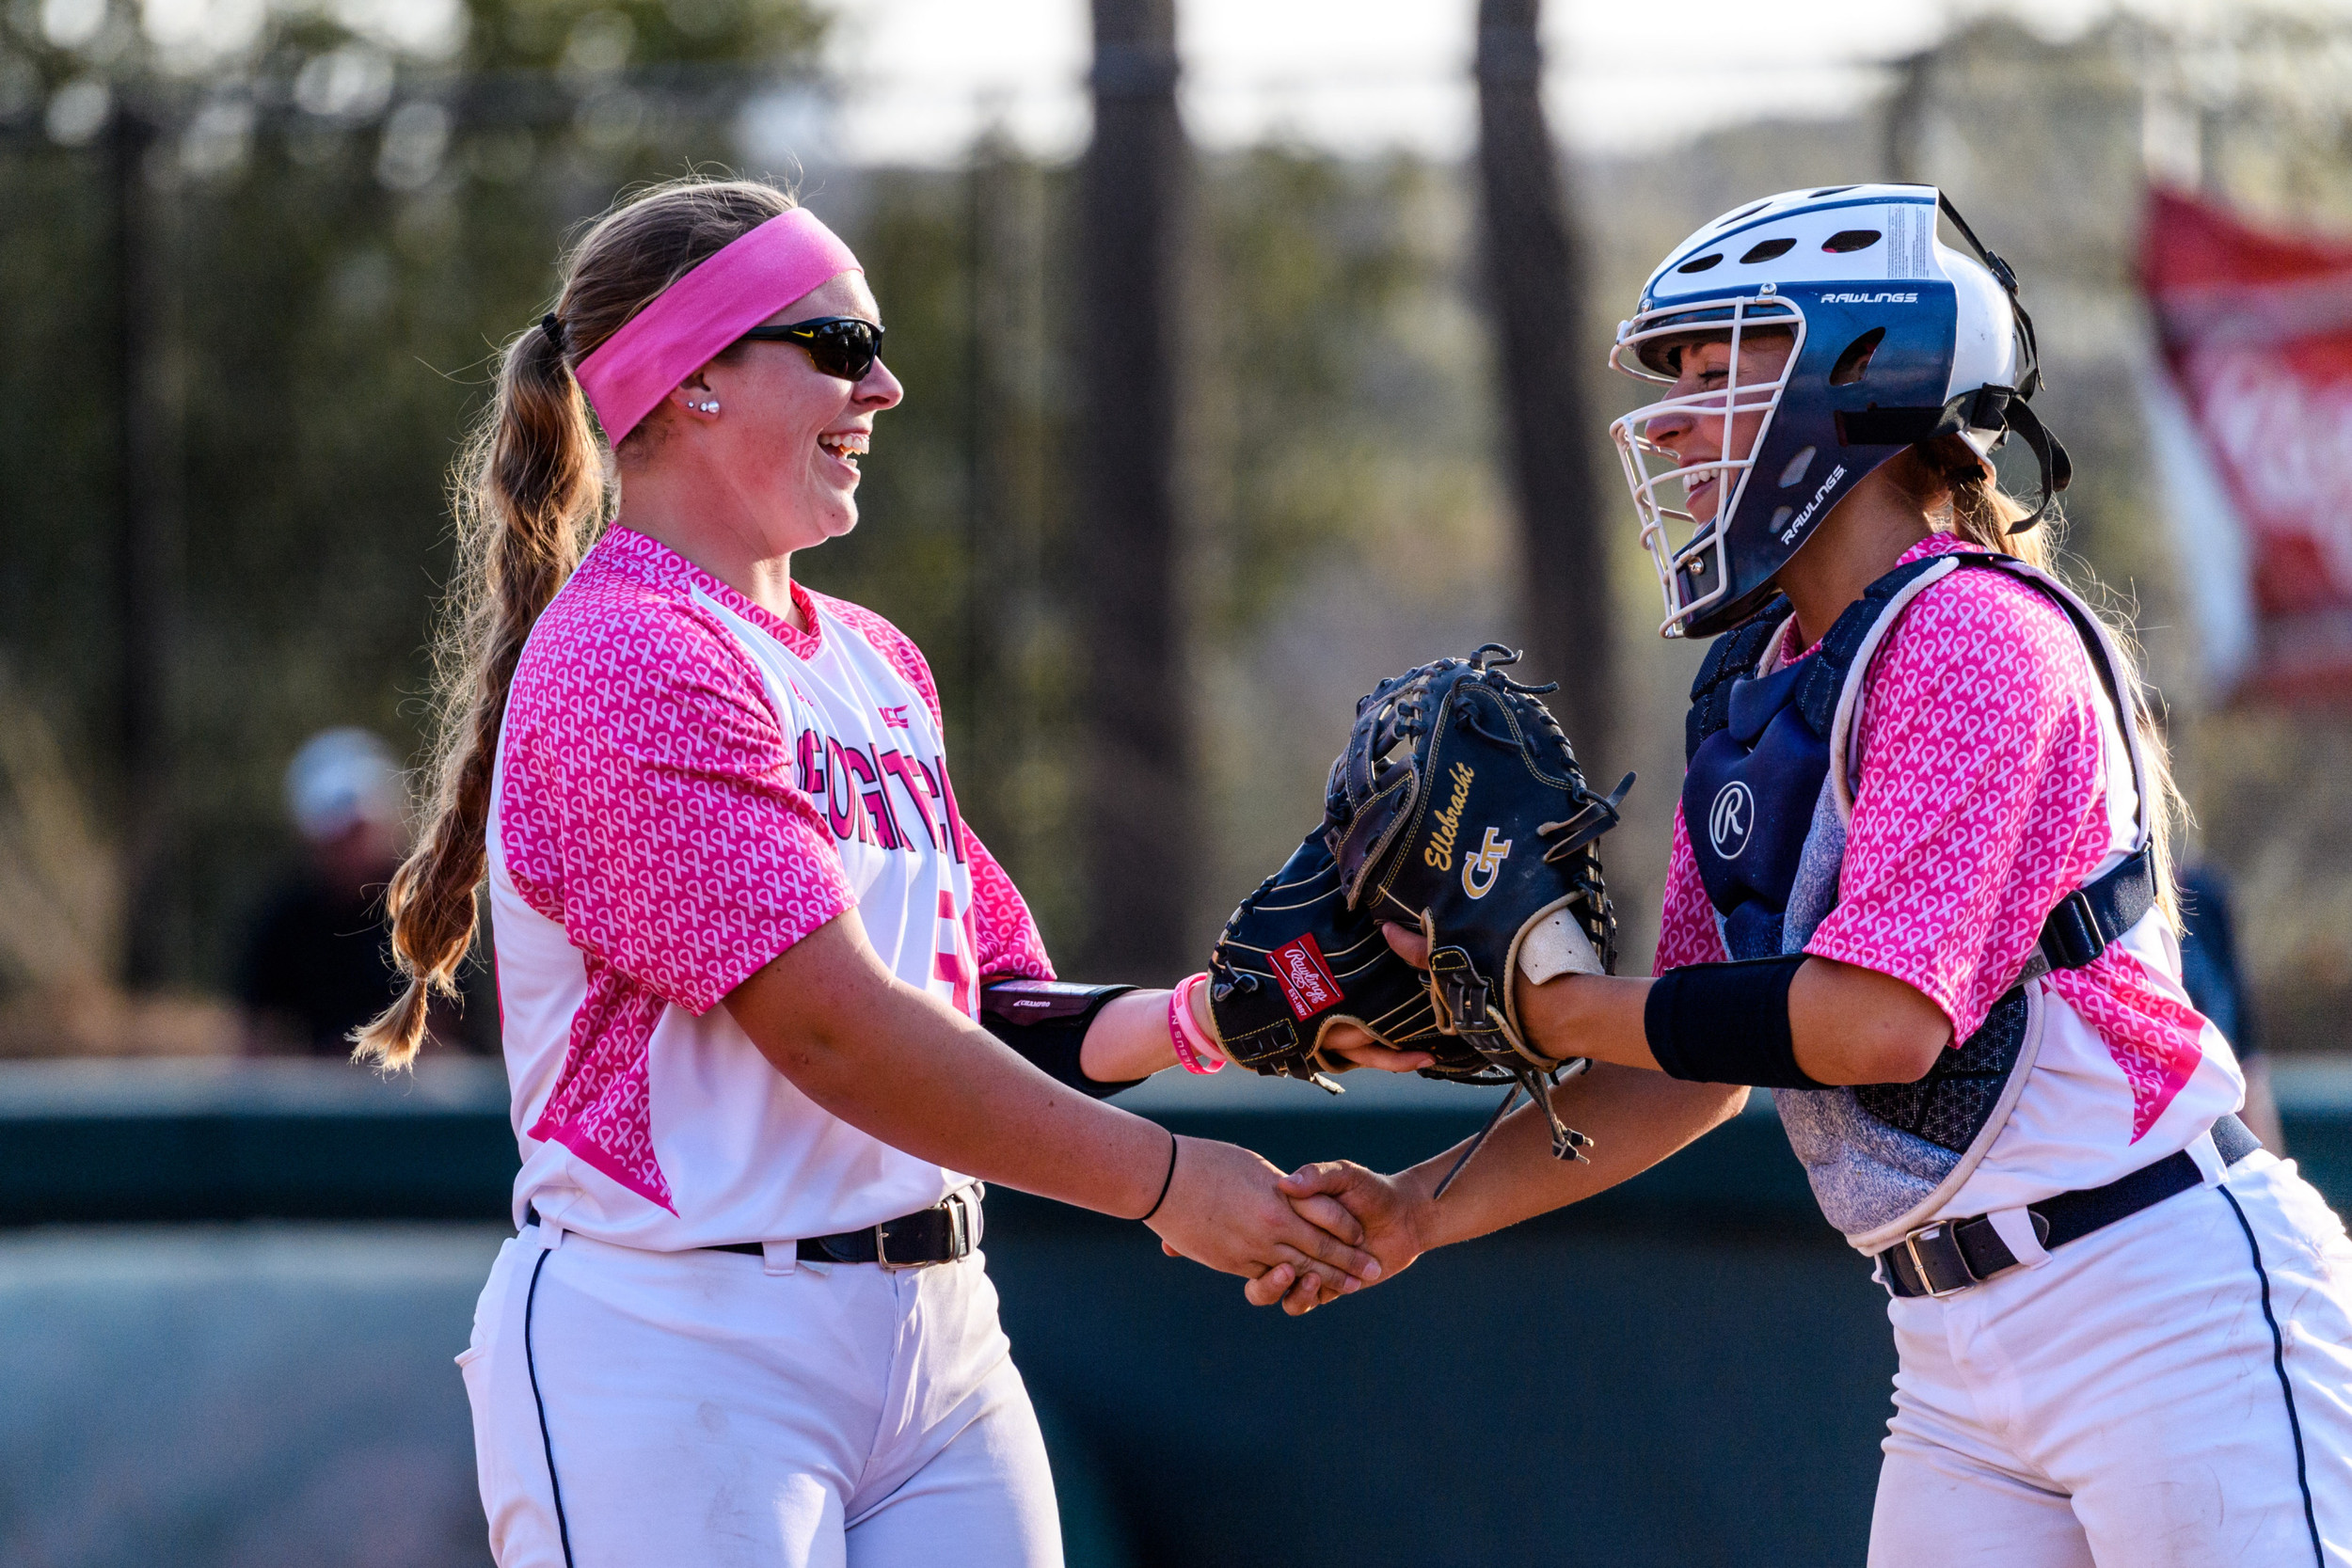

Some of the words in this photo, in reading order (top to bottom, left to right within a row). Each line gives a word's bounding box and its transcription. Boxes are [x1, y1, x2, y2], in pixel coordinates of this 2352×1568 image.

[1820, 293, 1918, 304] RAWLINGS
[1781, 464, 1847, 546] RAWLINGS
[1423, 761, 1475, 872] Ellebracht
